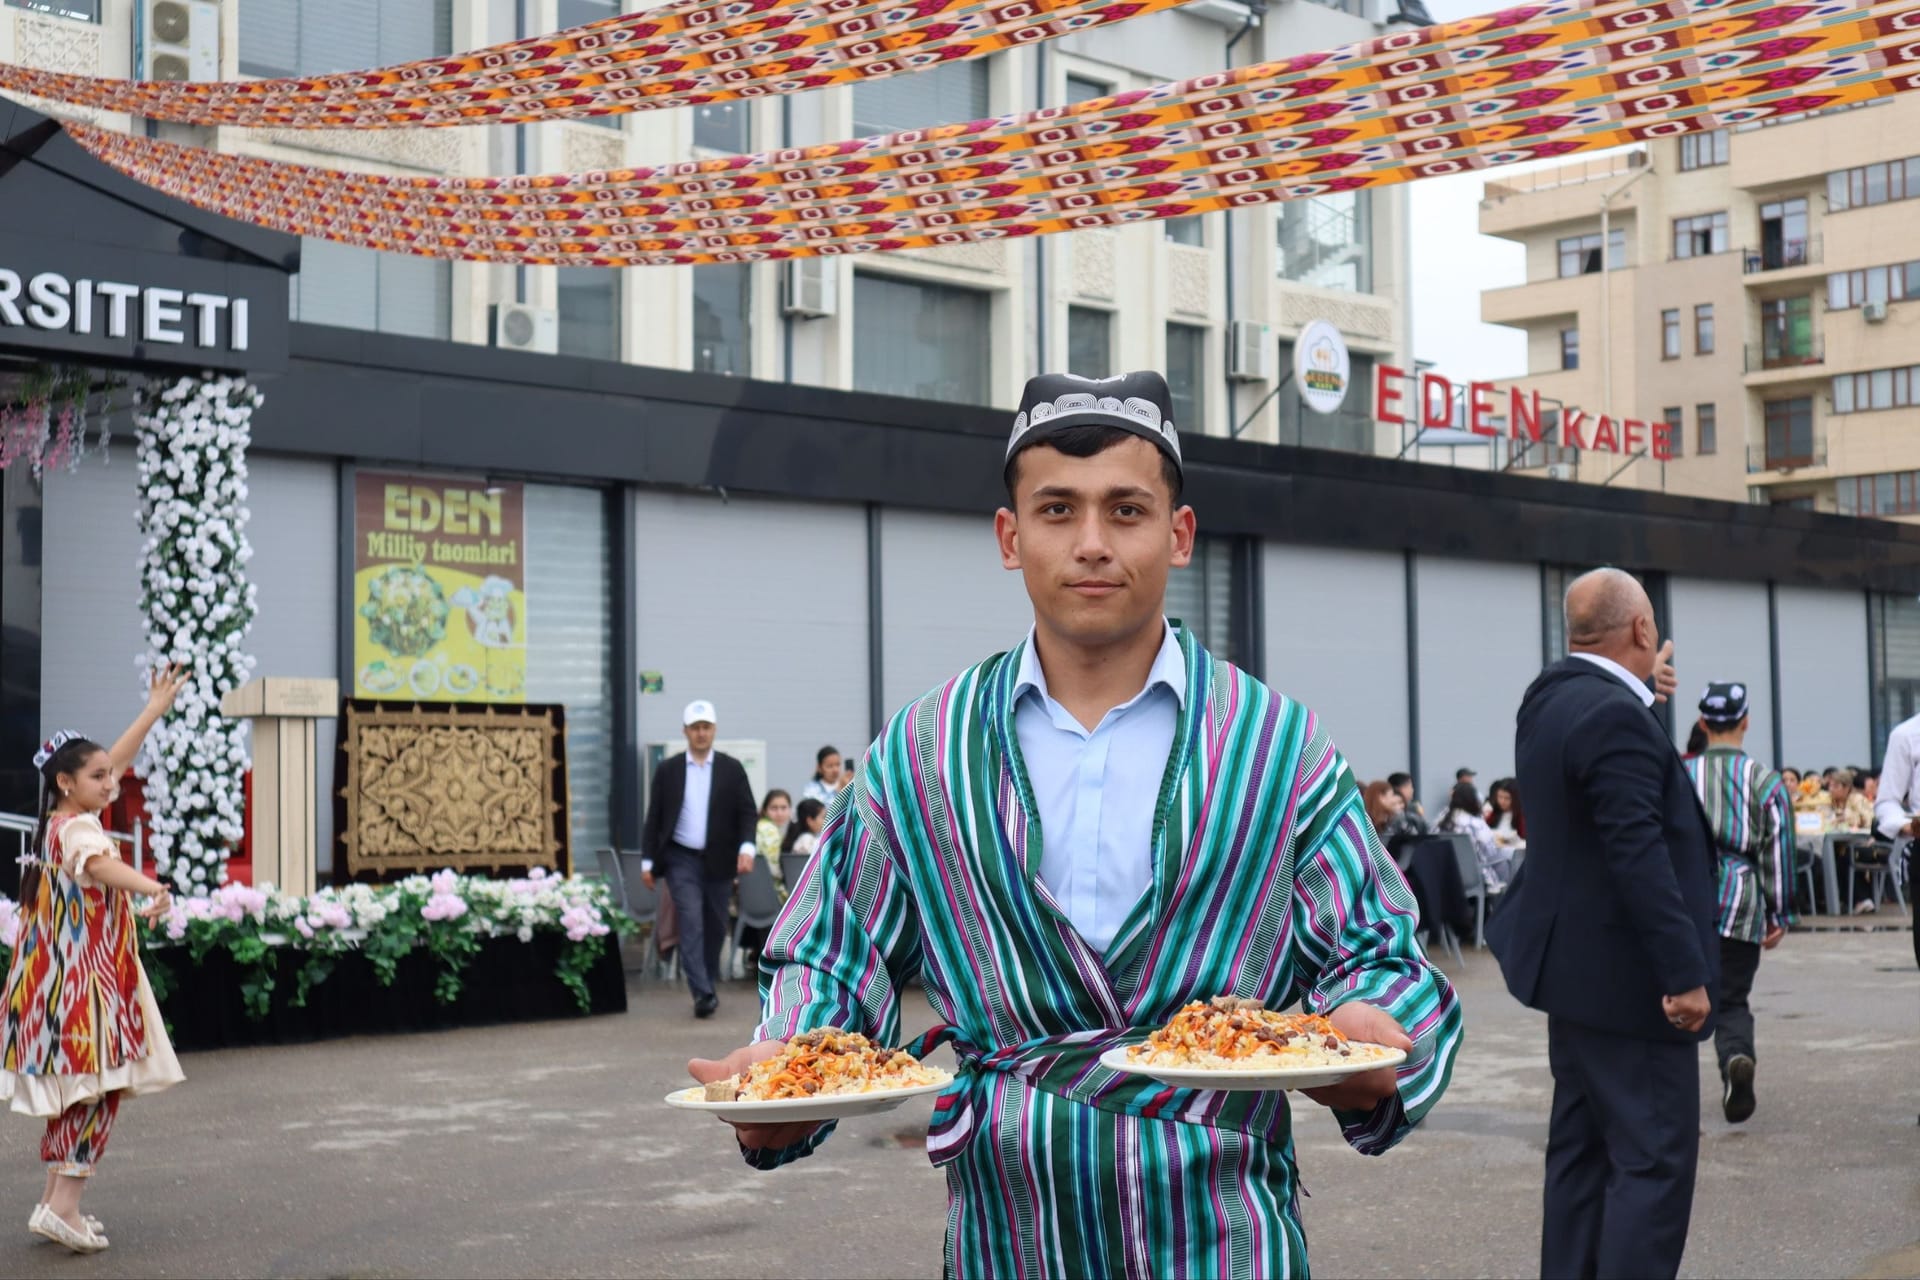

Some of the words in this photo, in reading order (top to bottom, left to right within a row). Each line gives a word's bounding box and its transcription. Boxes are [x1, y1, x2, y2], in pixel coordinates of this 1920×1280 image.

[1375, 364, 1543, 442] EDEN
[1560, 407, 1672, 461] KAFE
[384, 484, 502, 536] EDEN
[367, 532, 427, 563] Milliy
[432, 540, 516, 565] taomlari
